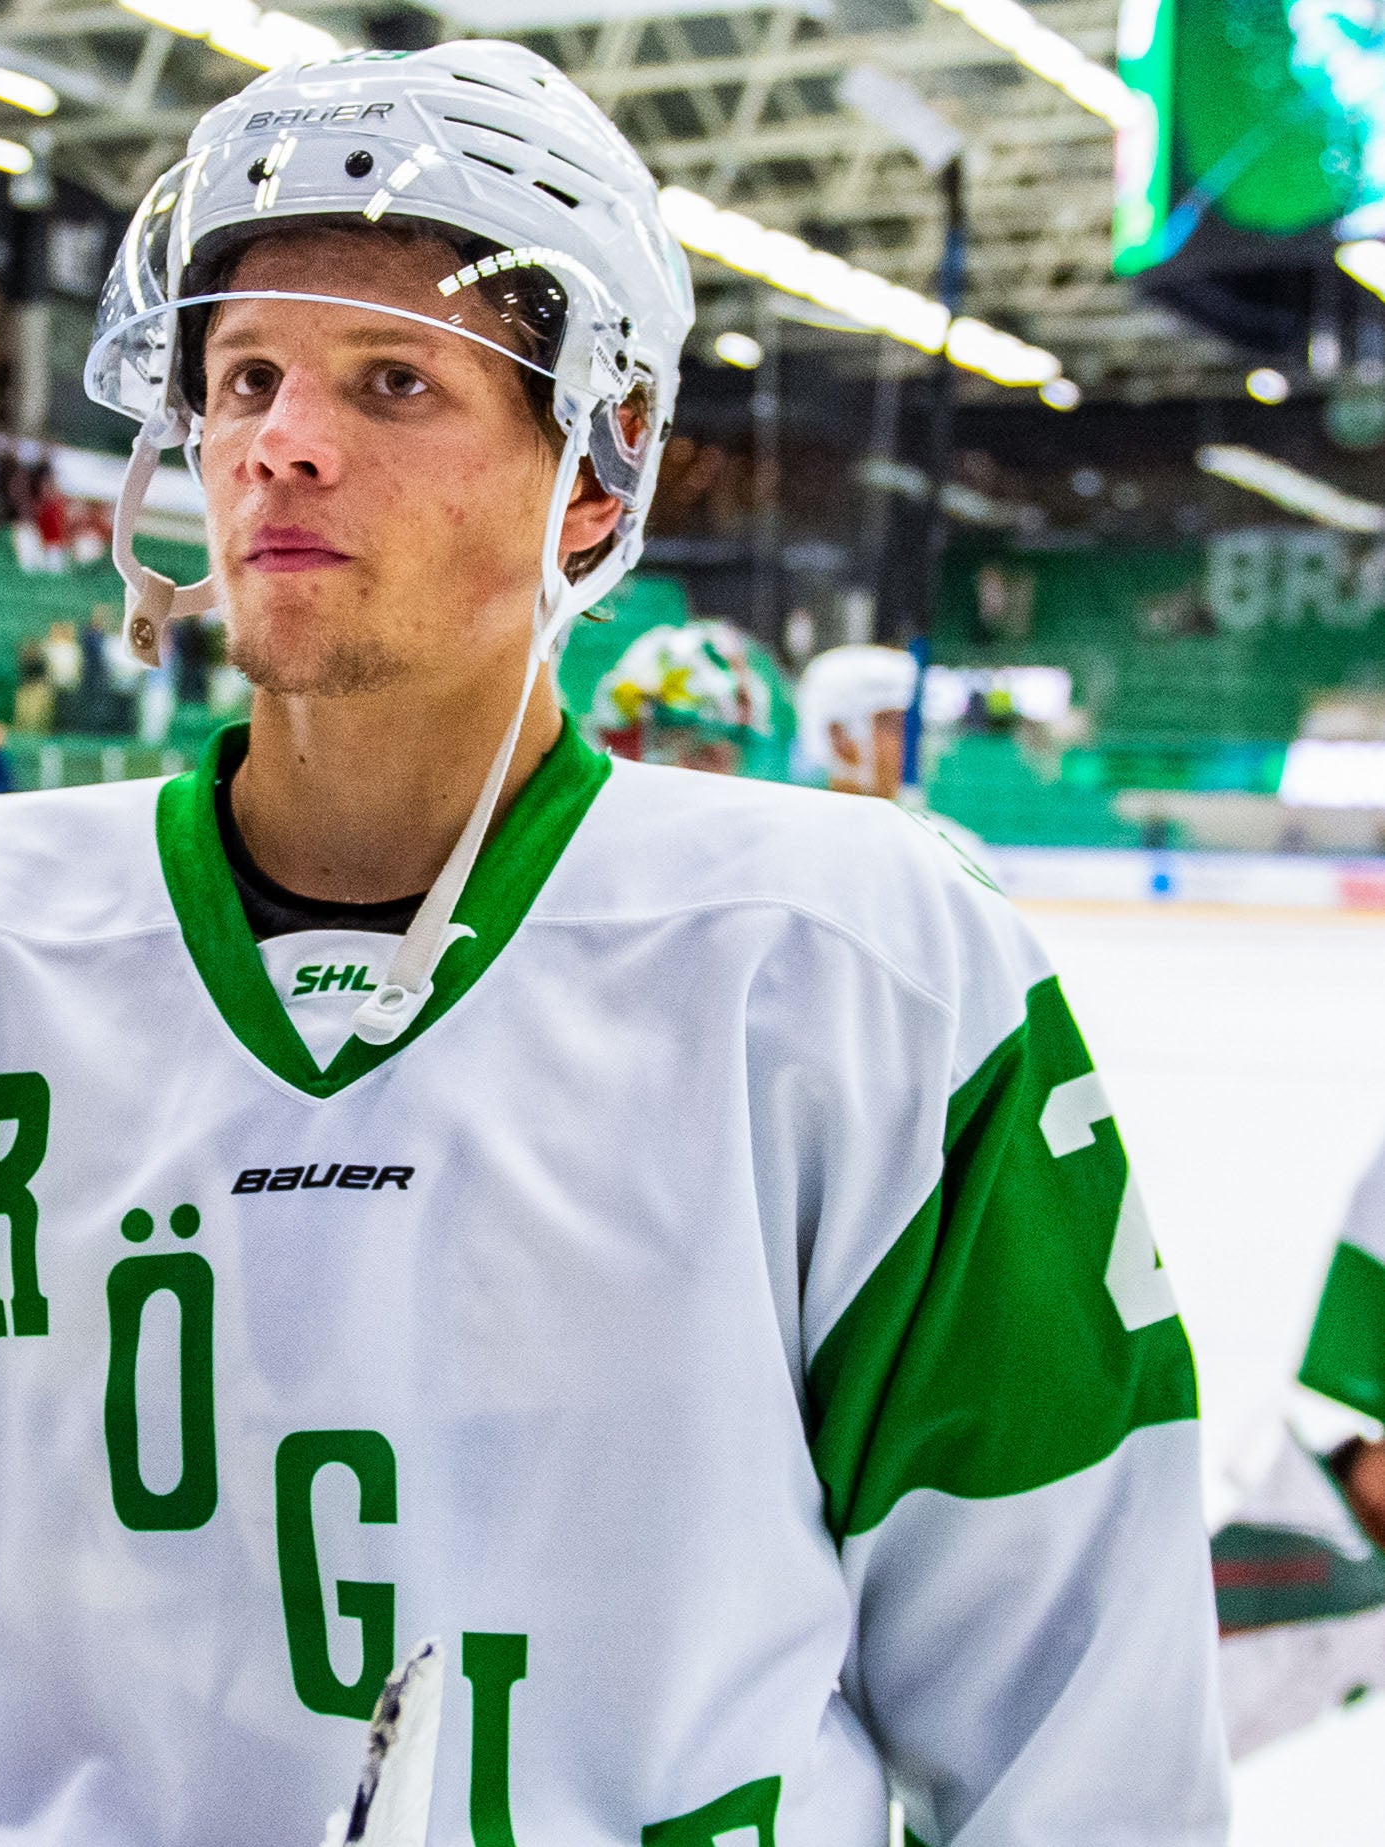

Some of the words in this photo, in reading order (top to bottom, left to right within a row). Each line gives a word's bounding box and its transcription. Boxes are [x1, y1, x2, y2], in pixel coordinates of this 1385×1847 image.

[244, 102, 395, 131] BAUER
[291, 964, 378, 996] SHL
[230, 1163, 415, 1195] BAUER
